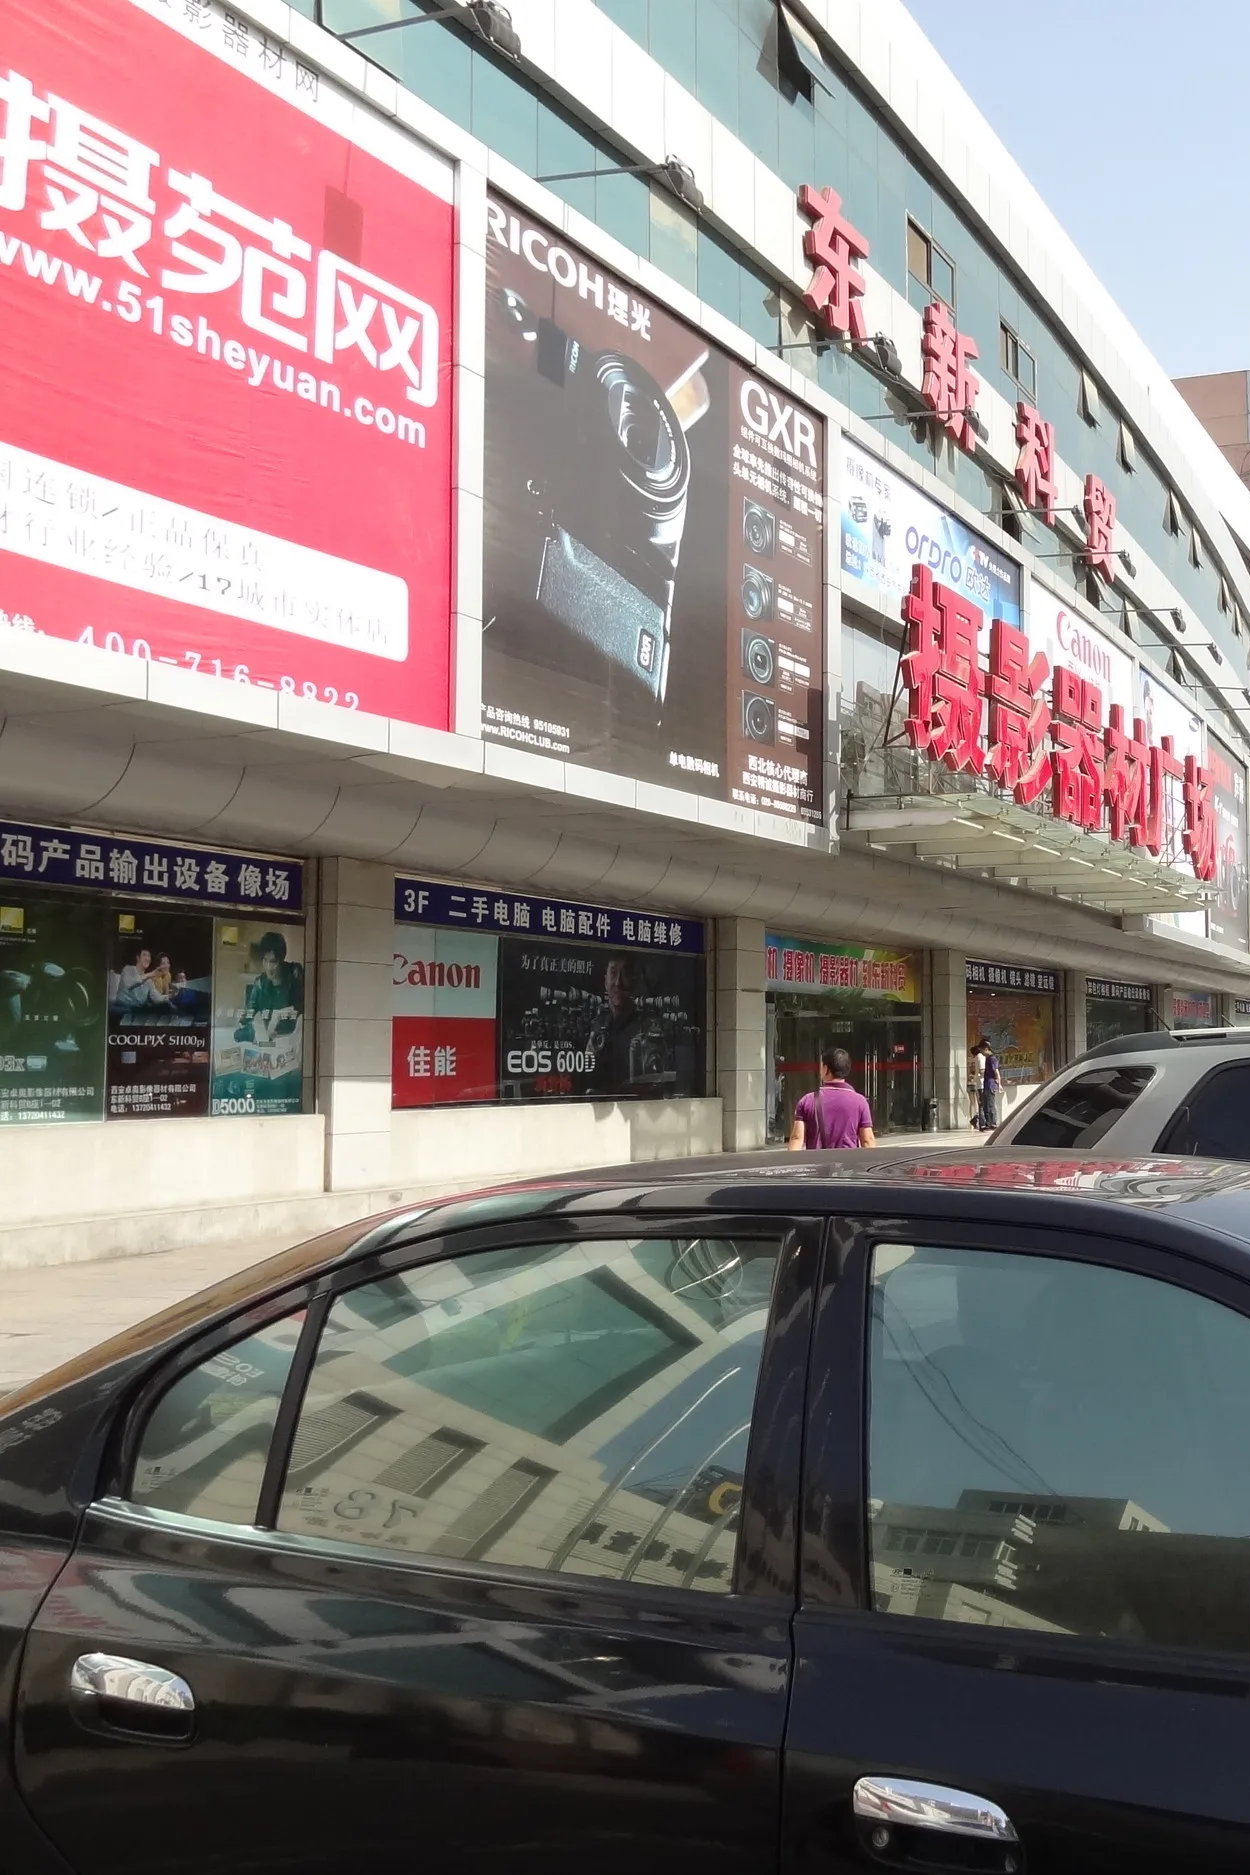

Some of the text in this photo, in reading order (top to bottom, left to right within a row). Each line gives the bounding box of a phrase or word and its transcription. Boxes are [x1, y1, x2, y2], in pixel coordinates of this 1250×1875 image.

[487, 199, 651, 341] RICOH 理光
[797, 183, 1117, 584] 东新科贸
[740, 379, 818, 468] GXR
[640, 634, 652, 666] GXR
[1056, 610, 1111, 683] Canon
[901, 563, 1217, 882] 摄影器材广场
[748, 754, 808, 786] 西北核心代理商
[403, 889, 683, 946] 3F 二手电脑 电脑配件 电脑维修
[392, 953, 480, 989] Canon
[521, 953, 595, 976] 为了真正美的照片
[108, 1033, 166, 1048] COOLPIX
[407, 1045, 456, 1077] 佳能
[507, 1050, 596, 1073] EOS 600D
[212, 1097, 255, 1115] D5000
